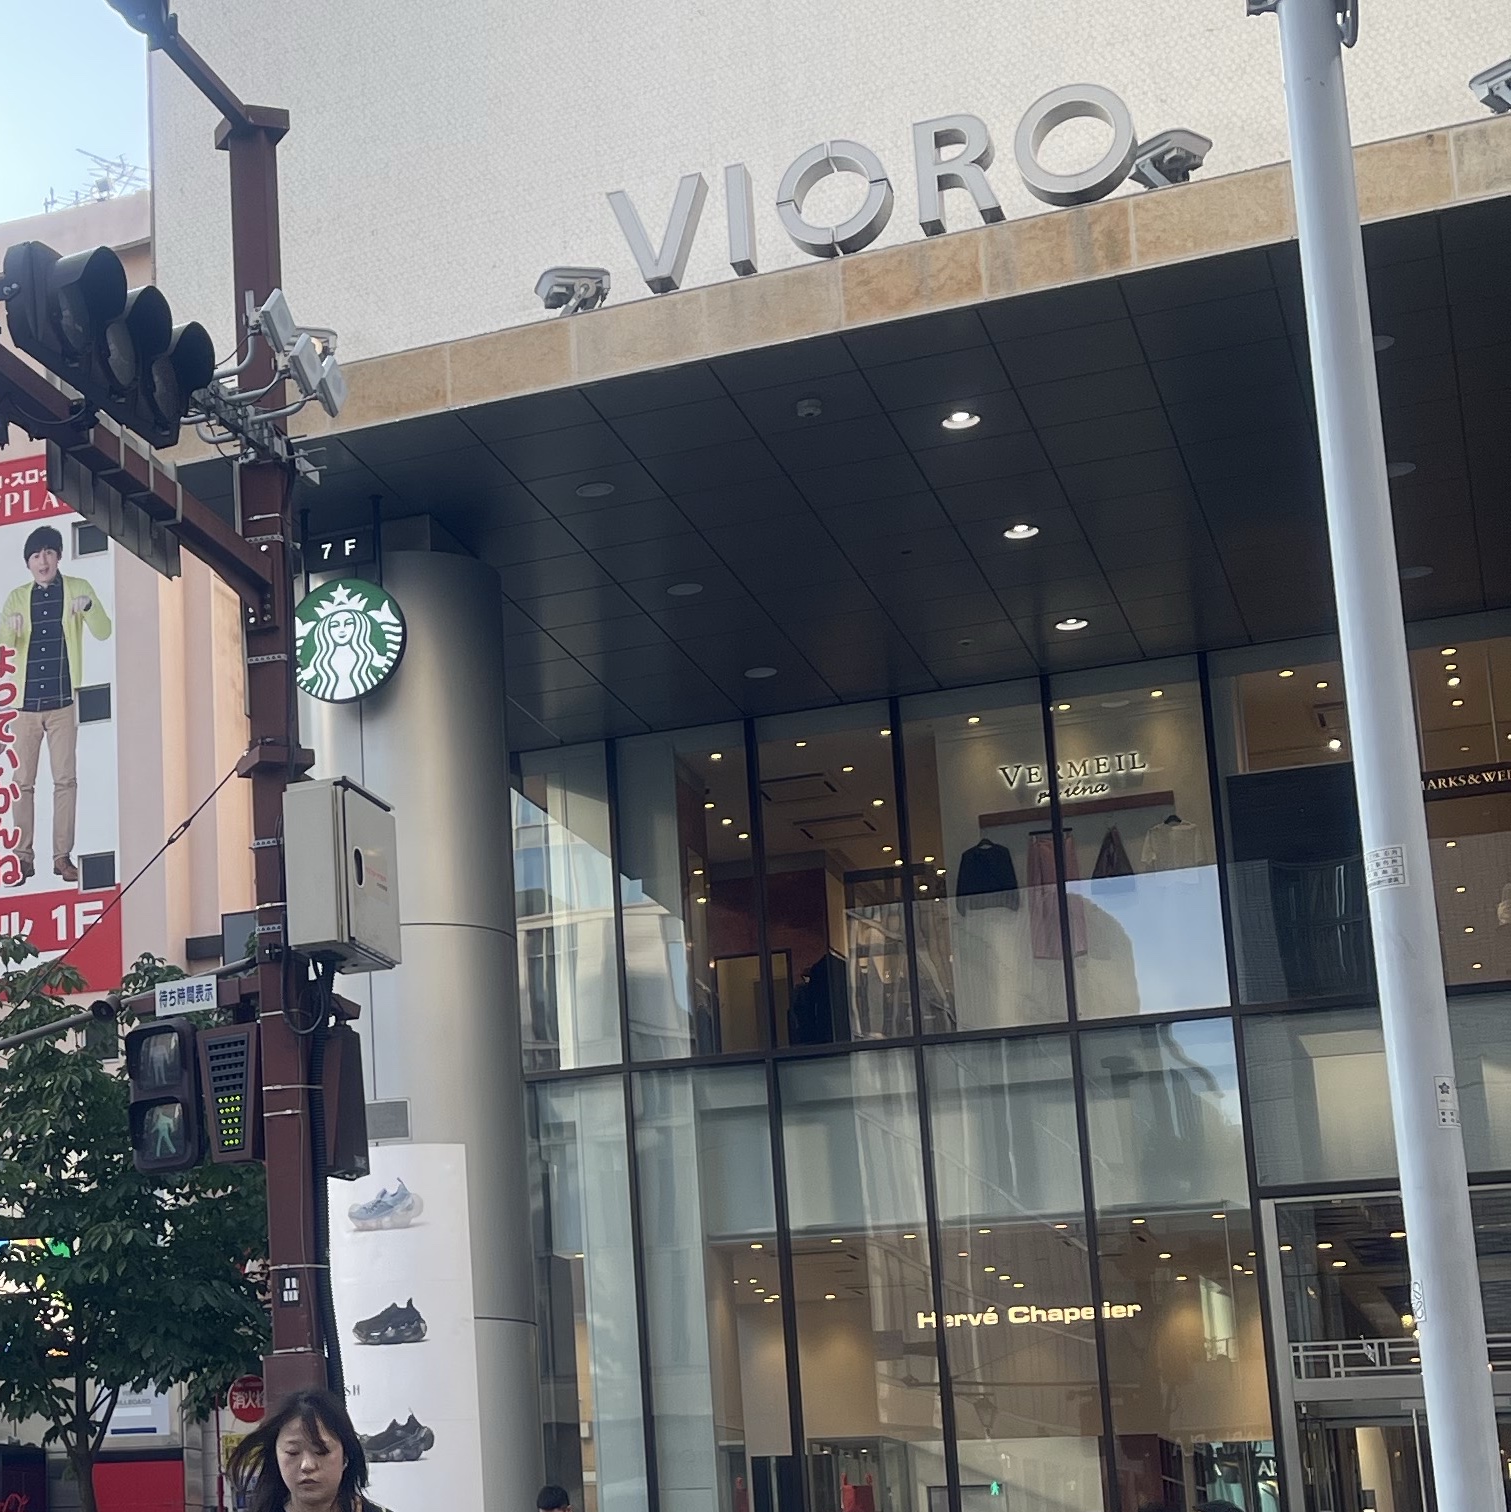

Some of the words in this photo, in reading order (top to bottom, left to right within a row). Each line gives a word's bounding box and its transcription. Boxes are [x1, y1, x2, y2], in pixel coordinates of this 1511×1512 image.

[606, 83, 1138, 293] VIORO
[4, 489, 68, 517] PLA
[51, 901, 104, 941] 1F
[159, 983, 214, 1008] 待ち時間表示
[916, 1306, 999, 1329] Hervé
[1008, 1301, 1142, 1324] Chapeier
